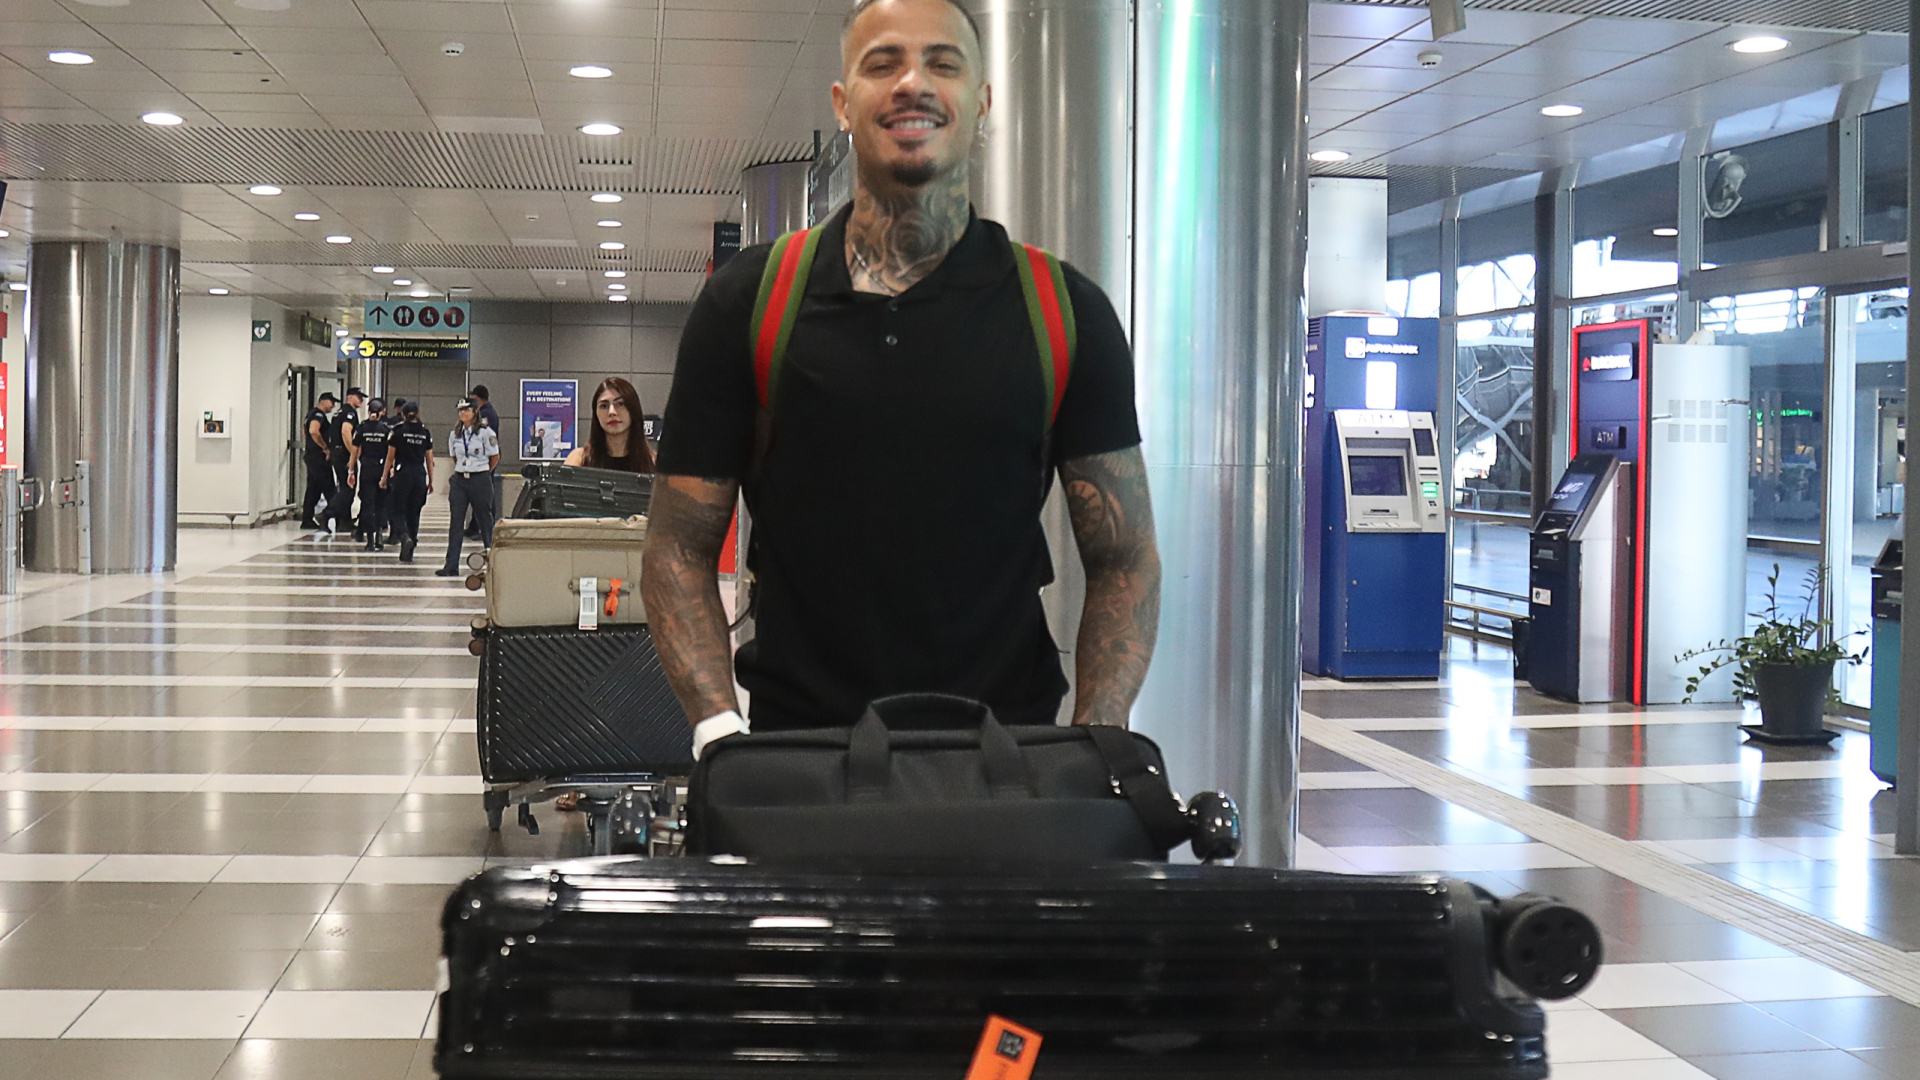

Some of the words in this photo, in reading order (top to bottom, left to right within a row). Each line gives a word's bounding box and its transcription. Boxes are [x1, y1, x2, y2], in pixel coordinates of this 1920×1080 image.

[377, 349, 389, 357] Car
[390, 349, 413, 357] rental
[414, 349, 438, 358] offices
[1596, 432, 1614, 443] ATM
